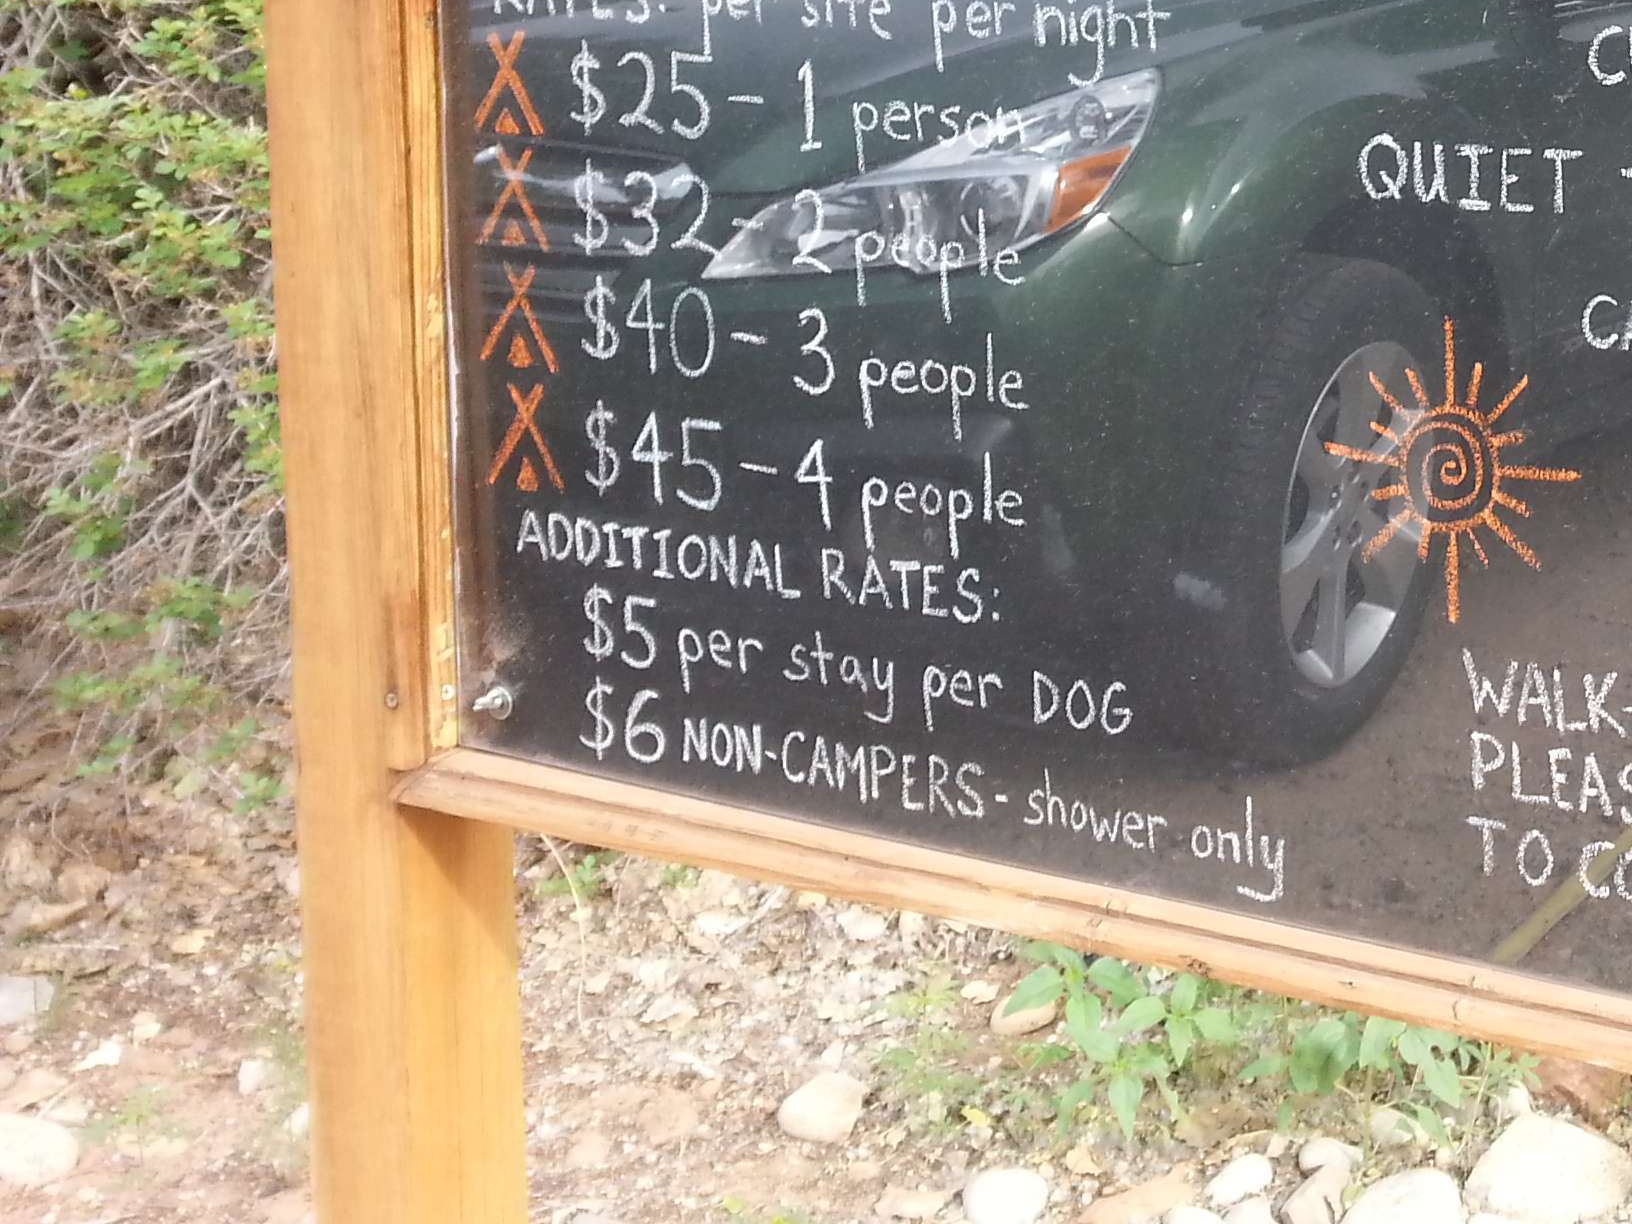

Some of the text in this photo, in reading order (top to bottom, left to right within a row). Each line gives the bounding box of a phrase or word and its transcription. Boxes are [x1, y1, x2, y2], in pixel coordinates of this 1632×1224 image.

[570, 40, 711, 139] $25
[797, 60, 823, 152] 1
[852, 97, 1023, 172] person
[1357, 133, 1583, 214] QUIET
[572, 158, 722, 259] $32
[792, 189, 831, 275] 2
[854, 208, 1025, 324] people
[580, 275, 716, 377] $40
[794, 307, 835, 395] 3
[858, 333, 1029, 441] people
[584, 399, 723, 511] $45
[797, 438, 833, 531] 4
[861, 452, 1027, 557] people
[517, 511, 1000, 624] ADDITIONAL RATES:
[584, 583, 1134, 735] $5 per stay per DOG
[581, 676, 666, 764] $6
[1023, 770, 1167, 853] shower
[1190, 797, 1285, 902] only
[1466, 815, 1554, 887] TO
